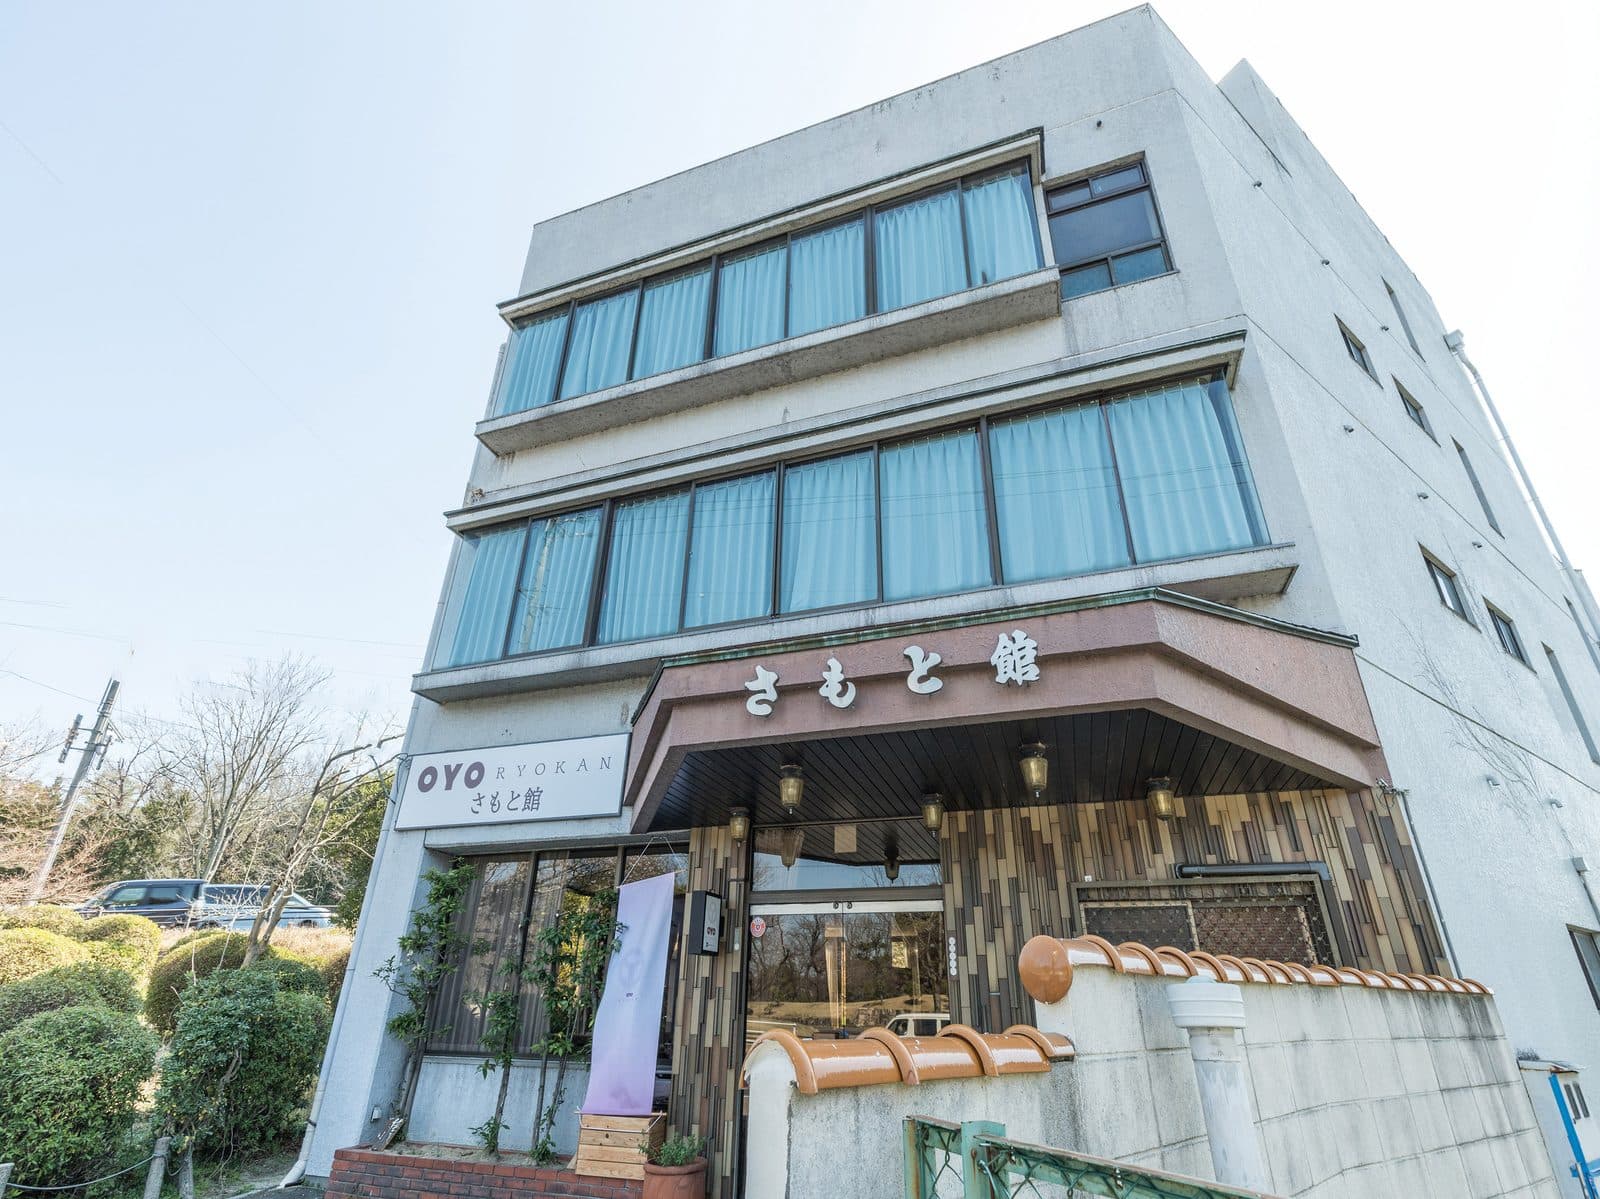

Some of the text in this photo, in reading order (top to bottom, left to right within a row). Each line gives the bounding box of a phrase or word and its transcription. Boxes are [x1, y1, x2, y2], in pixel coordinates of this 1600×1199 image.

[745, 629, 1040, 717] さもと館
[417, 756, 612, 793] OYO RYOKAN
[470, 787, 544, 815] さもと館
